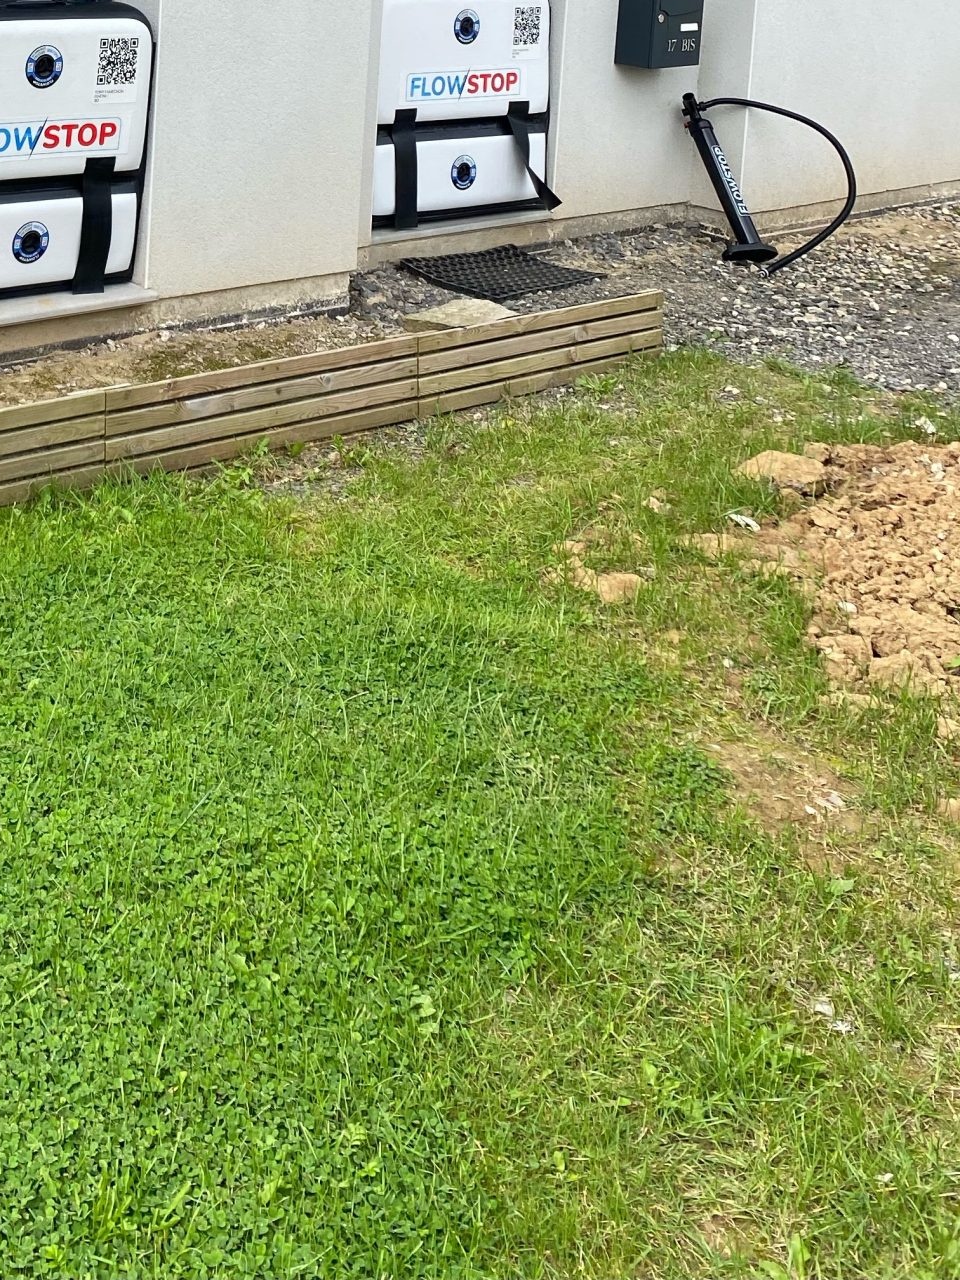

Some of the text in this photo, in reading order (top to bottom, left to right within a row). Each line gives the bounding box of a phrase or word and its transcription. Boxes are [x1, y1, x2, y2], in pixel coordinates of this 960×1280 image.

[667, 38, 696, 52] 17 BIS
[409, 71, 518, 98] FLOWSTOP
